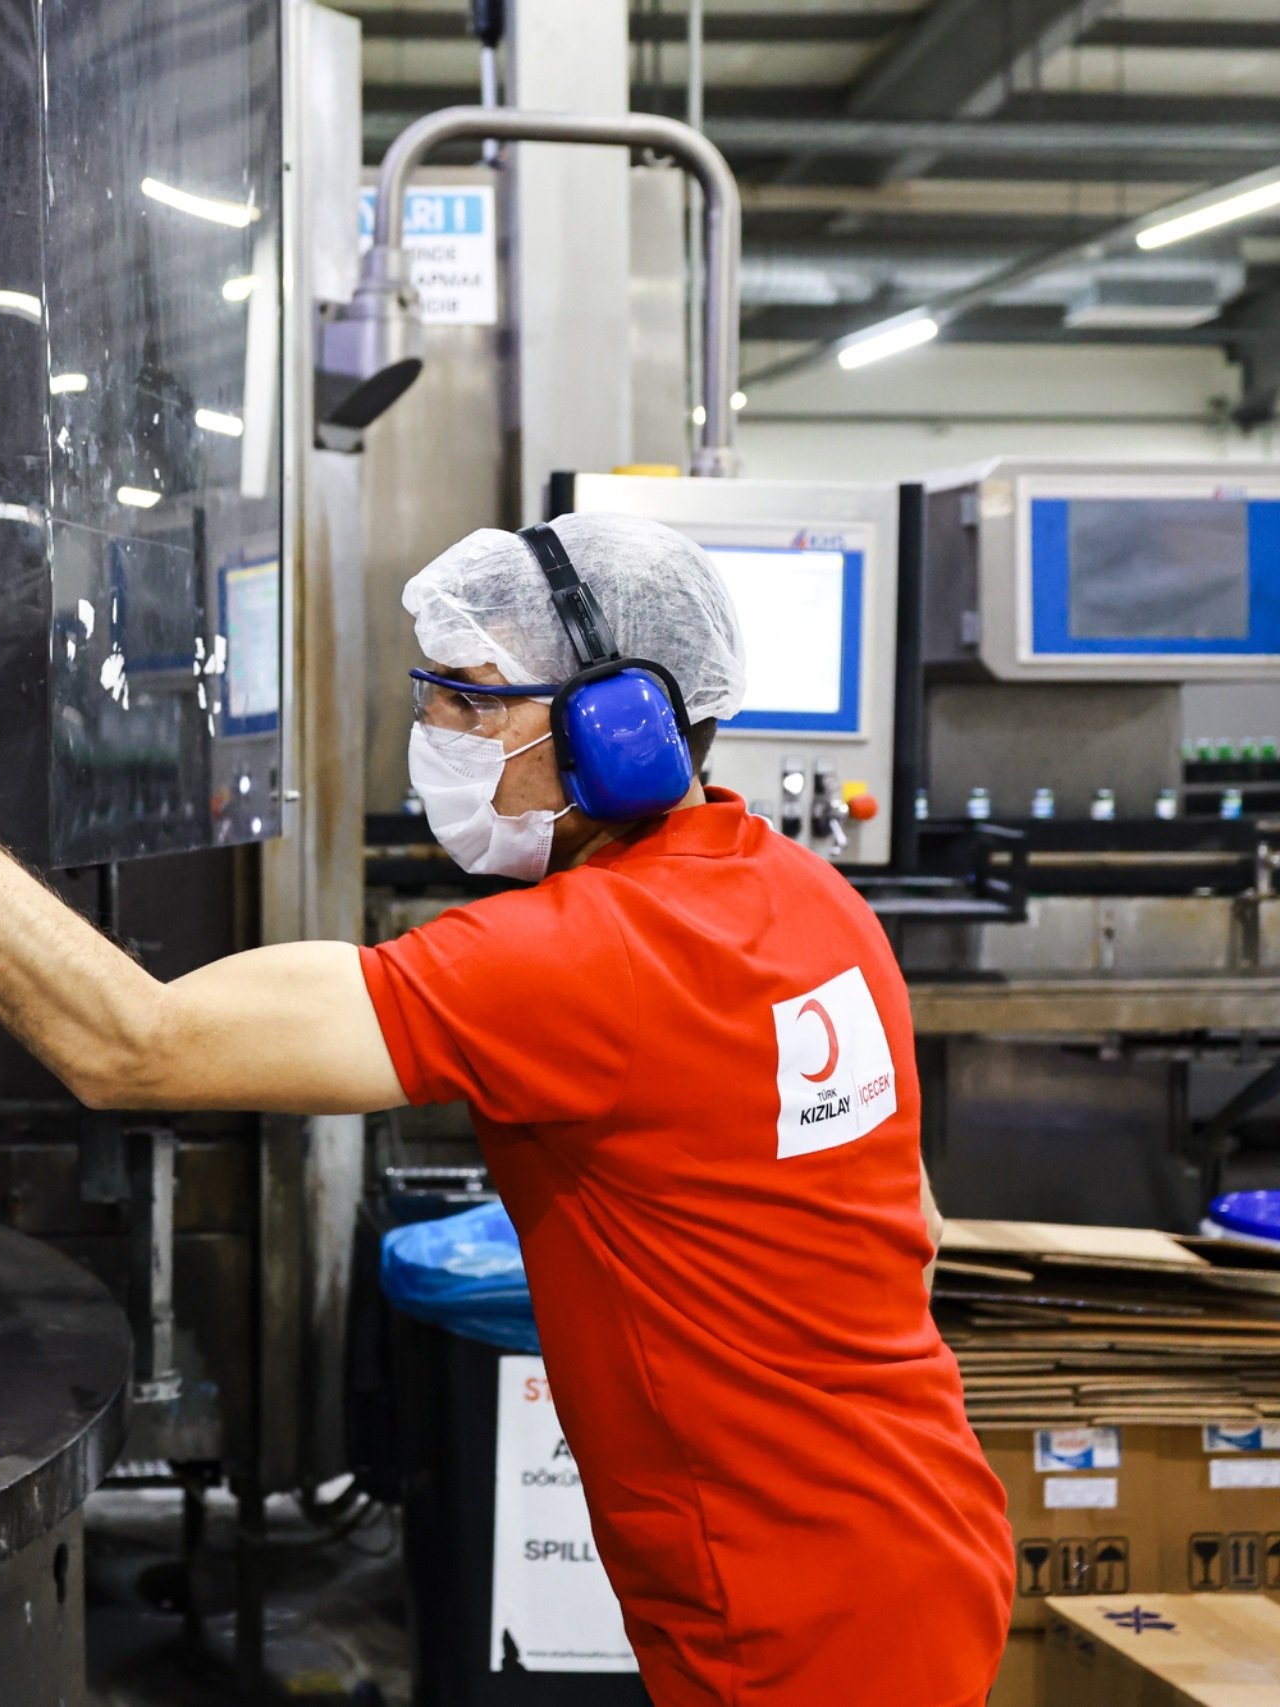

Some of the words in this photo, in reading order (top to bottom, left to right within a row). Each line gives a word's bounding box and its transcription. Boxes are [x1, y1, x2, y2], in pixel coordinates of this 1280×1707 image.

[817, 1087, 838, 1102] TÜRK
[858, 1073, 891, 1108] İÇECEK
[800, 1096, 851, 1126] KIZILAY
[524, 1539, 595, 1562] SPILL
